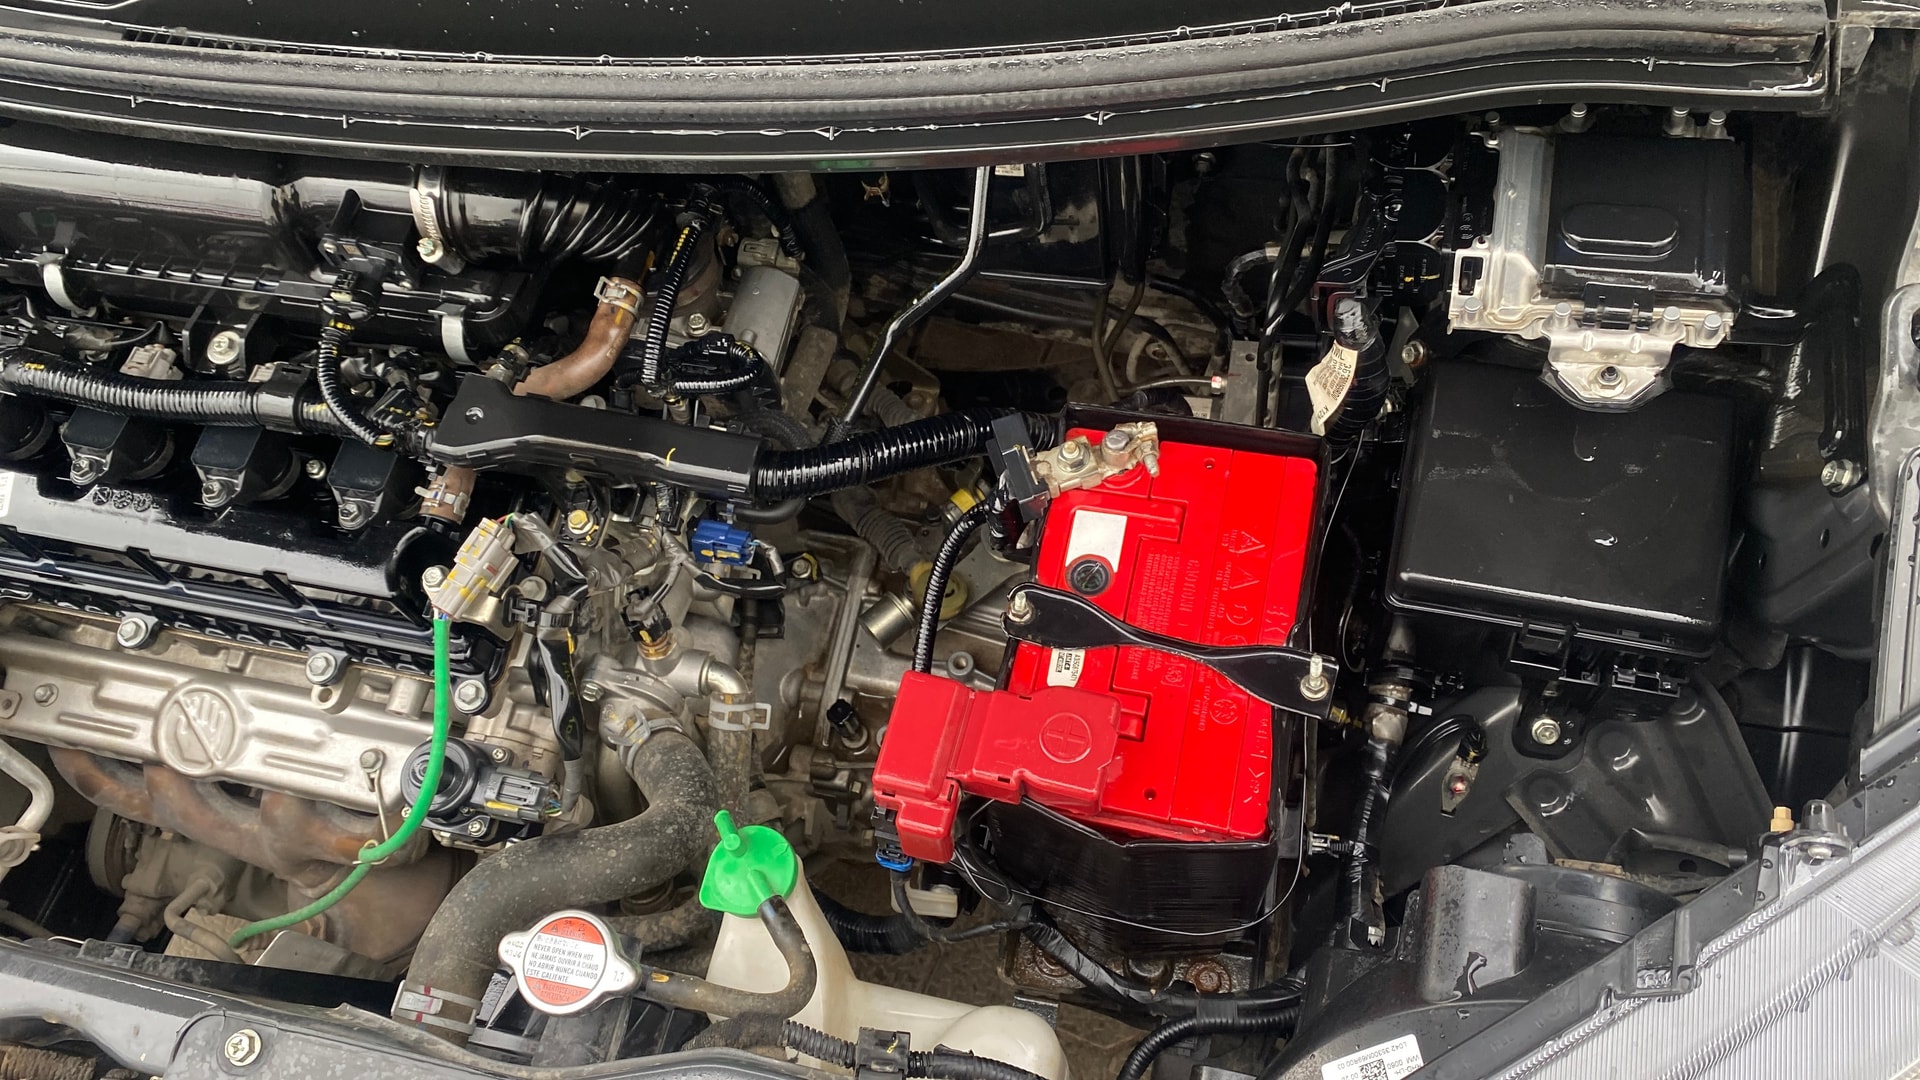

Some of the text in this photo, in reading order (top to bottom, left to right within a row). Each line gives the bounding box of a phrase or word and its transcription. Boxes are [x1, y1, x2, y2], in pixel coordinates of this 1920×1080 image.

[534, 944, 594, 960] NEVER OPEN WHEN HOT
[529, 960, 598, 980] NO ABRIR NUNCA CUANDO
[539, 953, 557, 963] JAMAIS
[559, 956, 576, 966] OUVRIR
[582, 961, 599, 972] CHAUD
[526, 968, 569, 982] ESTE CALIENTE
